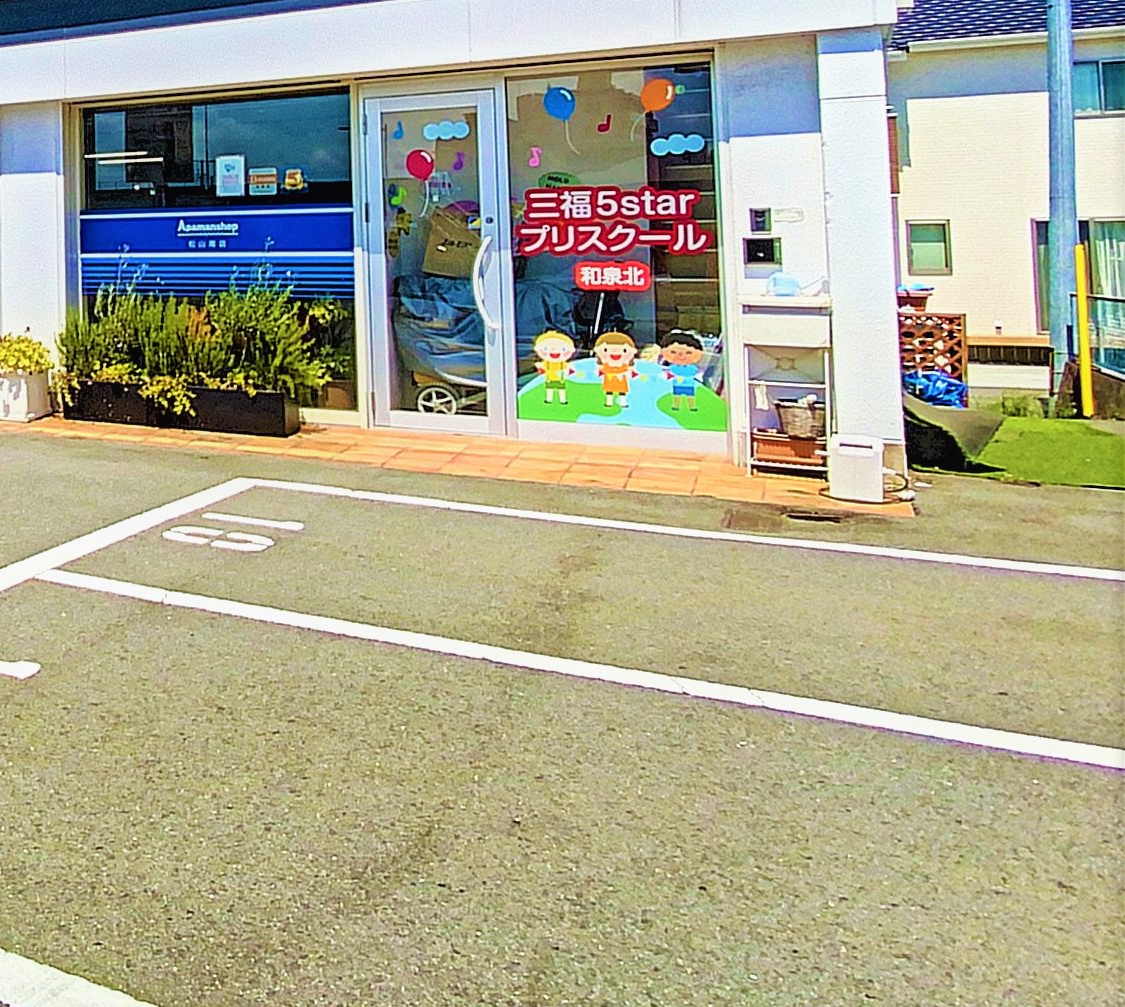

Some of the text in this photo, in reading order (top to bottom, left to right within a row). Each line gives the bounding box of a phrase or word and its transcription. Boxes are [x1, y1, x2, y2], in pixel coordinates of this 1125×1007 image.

[528, 190, 696, 219] 三福5star
[177, 219, 239, 234] Apamanshop
[520, 223, 708, 253] プリスクール
[579, 266, 646, 286] 和泉北
